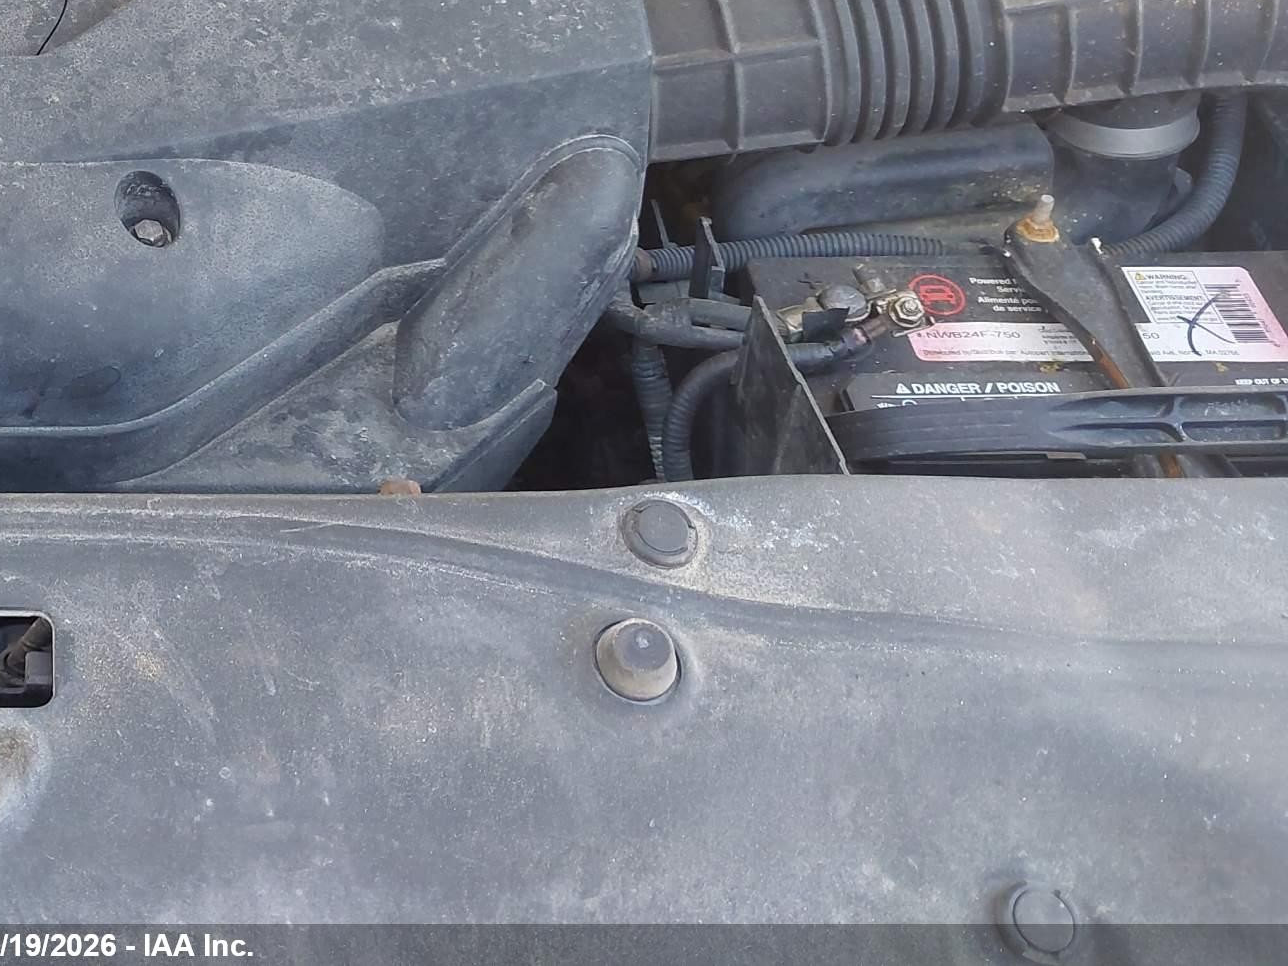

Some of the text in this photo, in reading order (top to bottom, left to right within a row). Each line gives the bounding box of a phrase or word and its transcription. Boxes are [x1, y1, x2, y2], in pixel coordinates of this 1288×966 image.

[969, 277, 1011, 285] Powered
[911, 382, 982, 394] DANGER
[996, 381, 1061, 393] POISON
